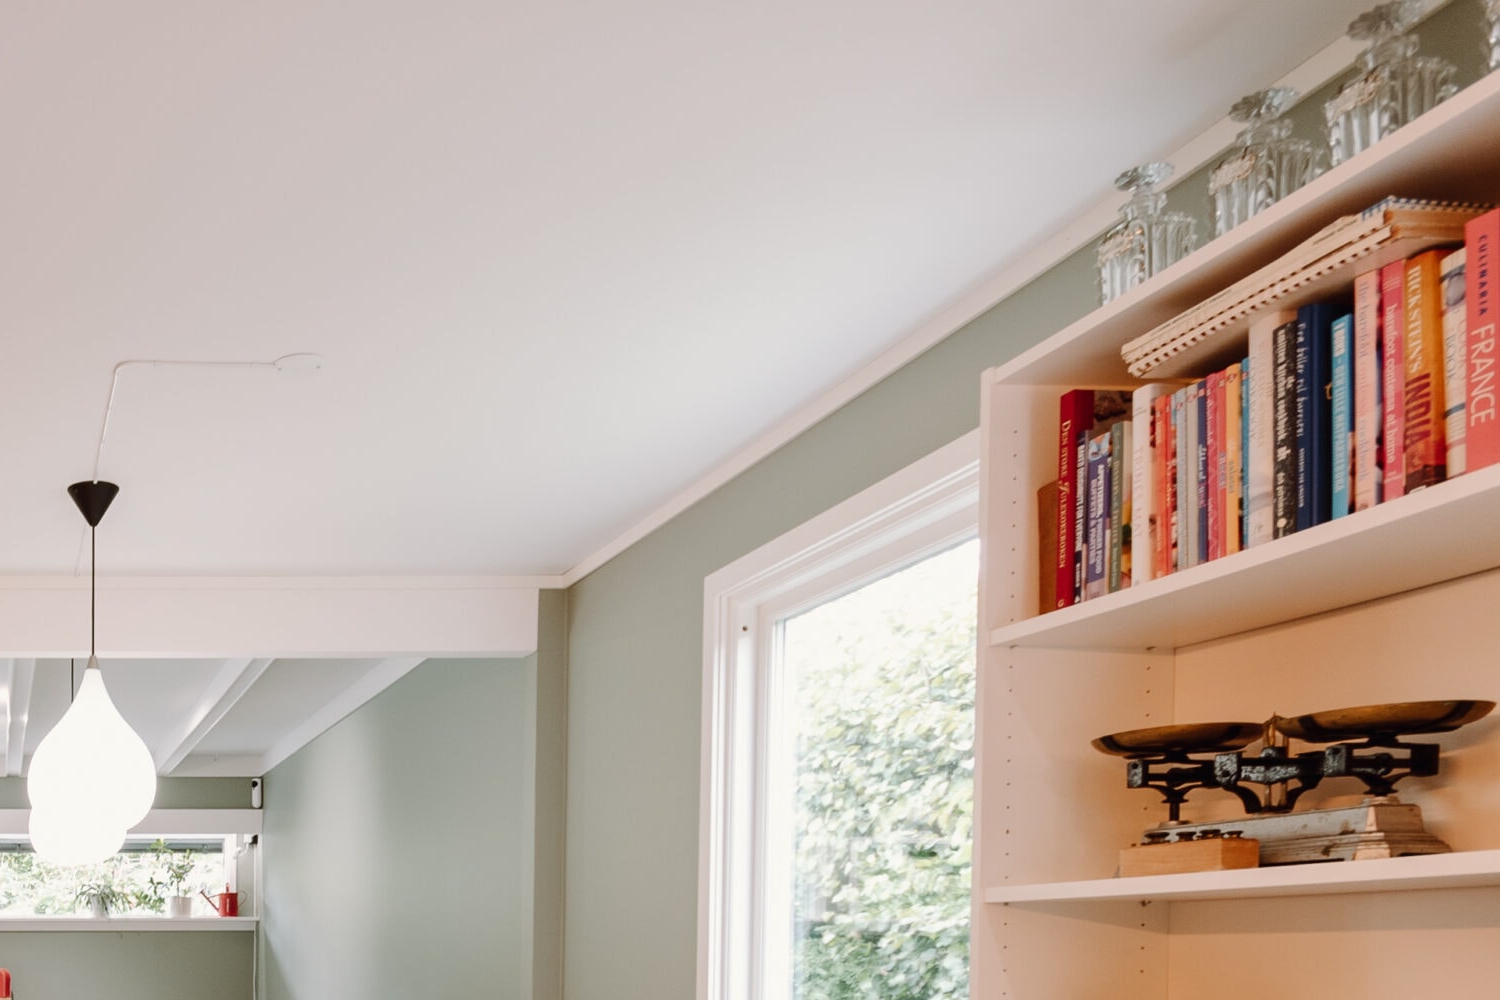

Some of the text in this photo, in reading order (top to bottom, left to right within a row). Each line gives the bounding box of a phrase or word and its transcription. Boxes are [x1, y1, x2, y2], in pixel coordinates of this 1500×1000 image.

[1358, 282, 1369, 303] the
[1357, 306, 1370, 358] barefoot
[1470, 234, 1495, 427] CULINARIA FRANCE
[1277, 363, 1288, 399] kitchen
[1385, 304, 1398, 463] barefoot contessa at home
[1403, 266, 1431, 452] RICK STEIN'S INDIA
[1094, 550, 1102, 574] FOOD
